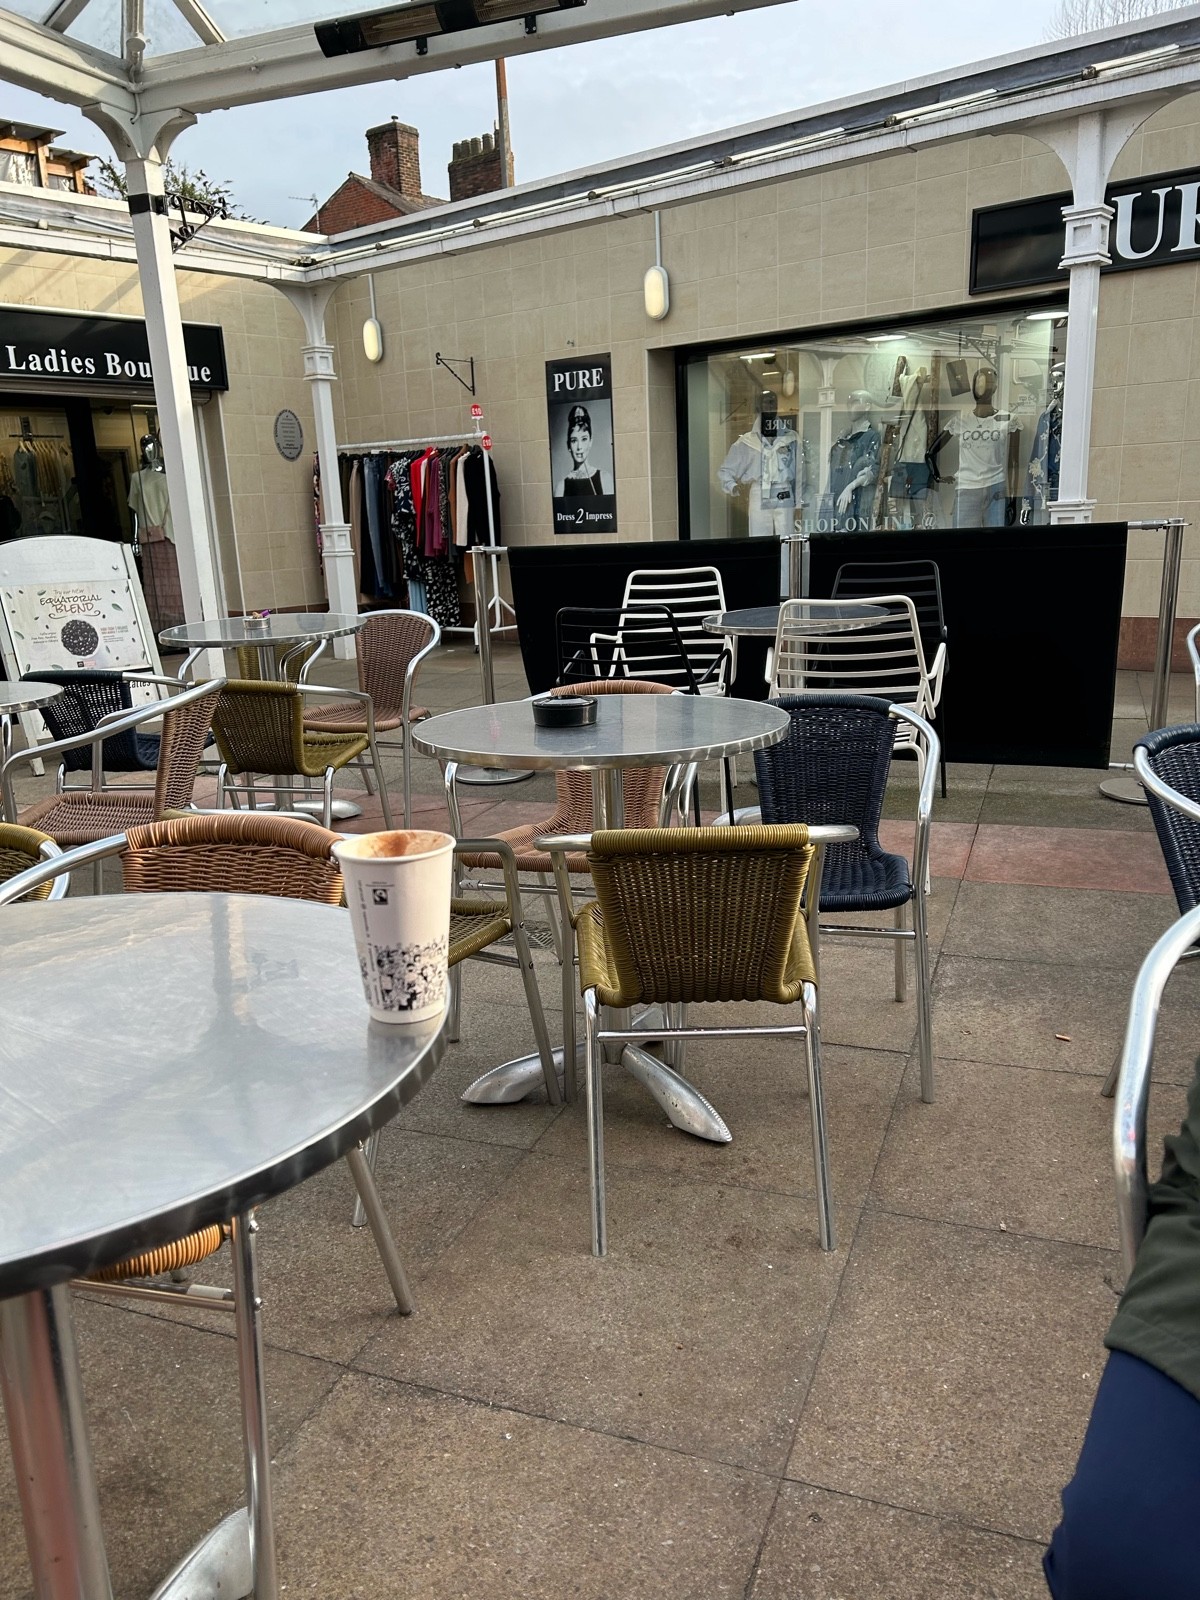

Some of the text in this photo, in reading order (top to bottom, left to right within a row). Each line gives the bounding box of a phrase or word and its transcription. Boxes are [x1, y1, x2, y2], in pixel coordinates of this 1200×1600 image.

[5, 345, 212, 383] Ladies Bouue
[553, 368, 604, 392] PURE
[962, 430, 1001, 442] COCO
[557, 508, 613, 524] Dress 2 Impress
[794, 518, 839, 533] SHOP
[845, 515, 915, 532] ONLINE
[40, 594, 102, 607] EQUATORIAL
[55, 602, 93, 613] BLEND
